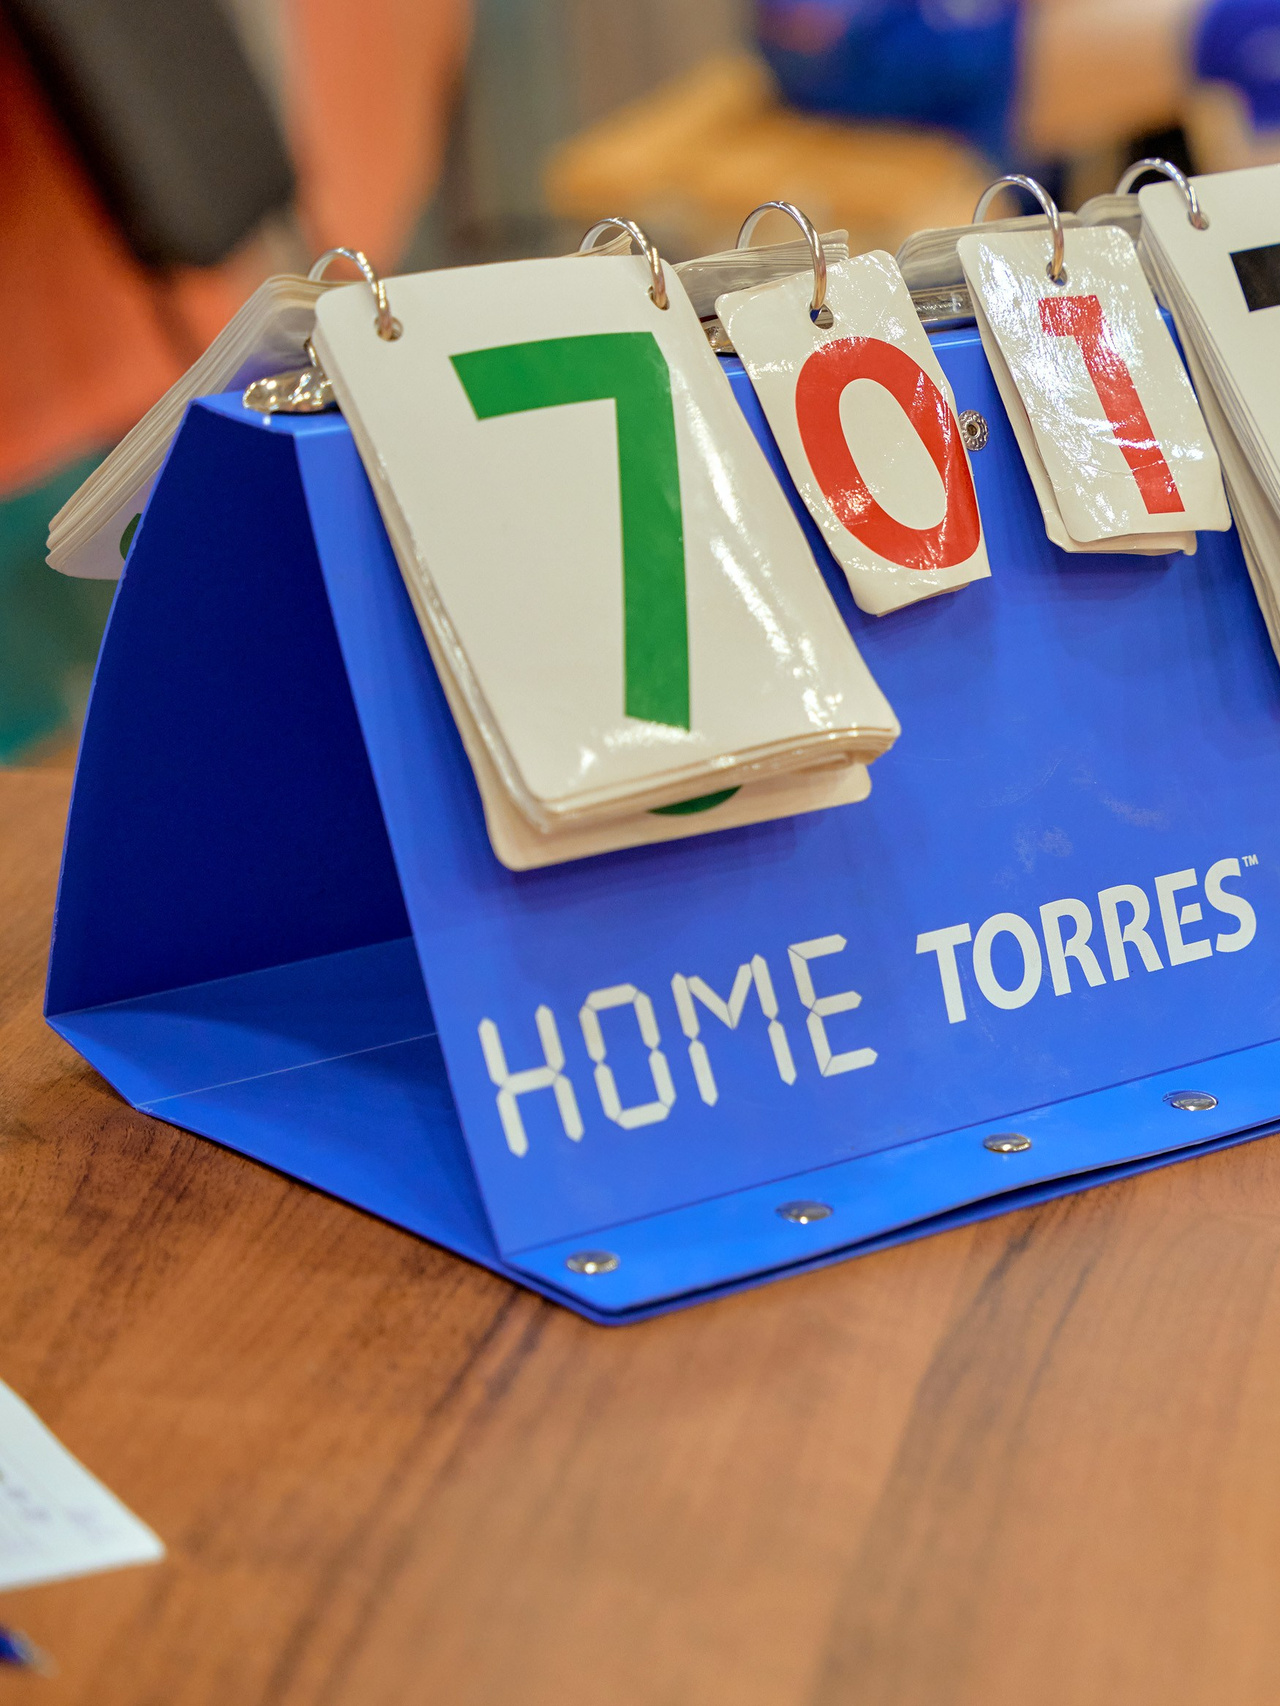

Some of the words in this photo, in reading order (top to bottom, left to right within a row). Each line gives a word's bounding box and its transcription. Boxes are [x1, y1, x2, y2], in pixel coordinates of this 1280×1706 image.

[795, 335, 981, 571] 0
[1039, 294, 1185, 515] 1
[449, 331, 692, 732] 7
[477, 933, 879, 1158] HOME
